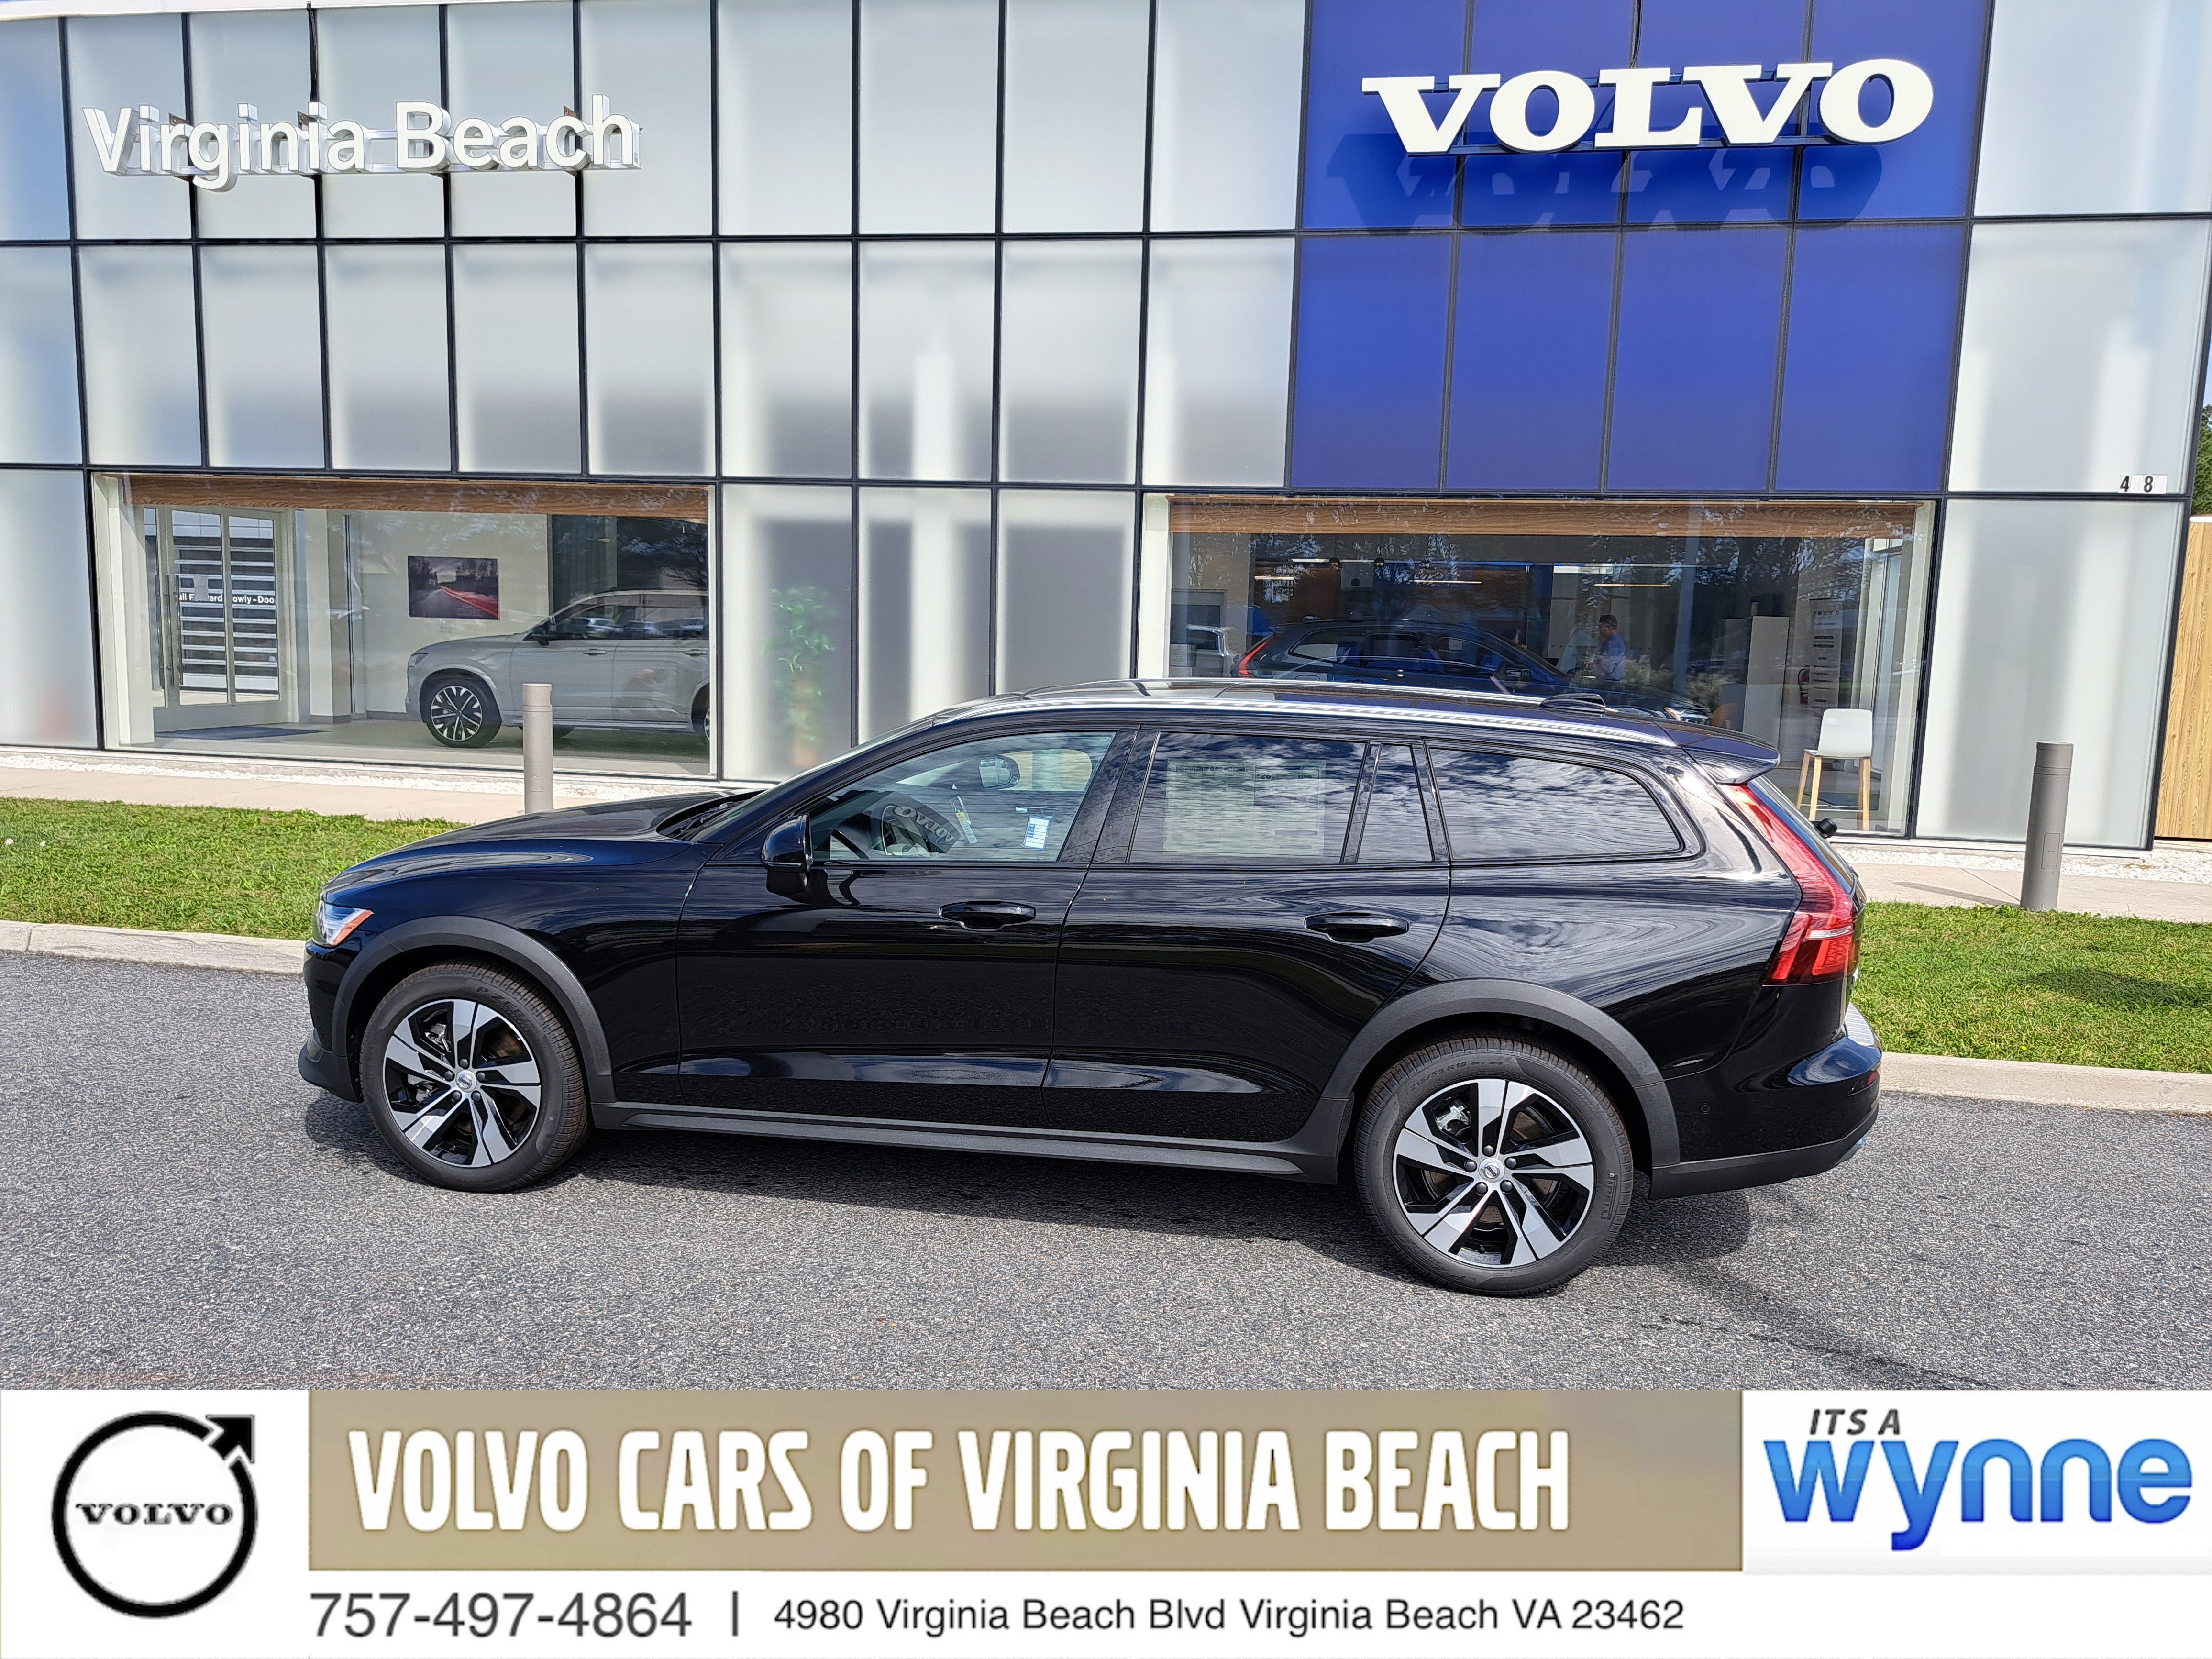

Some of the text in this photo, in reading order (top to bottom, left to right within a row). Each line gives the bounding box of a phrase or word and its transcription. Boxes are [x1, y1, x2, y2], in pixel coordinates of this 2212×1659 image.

[81, 94, 641, 192] Virginia Beach
[1361, 58, 1934, 153] VOLVO
